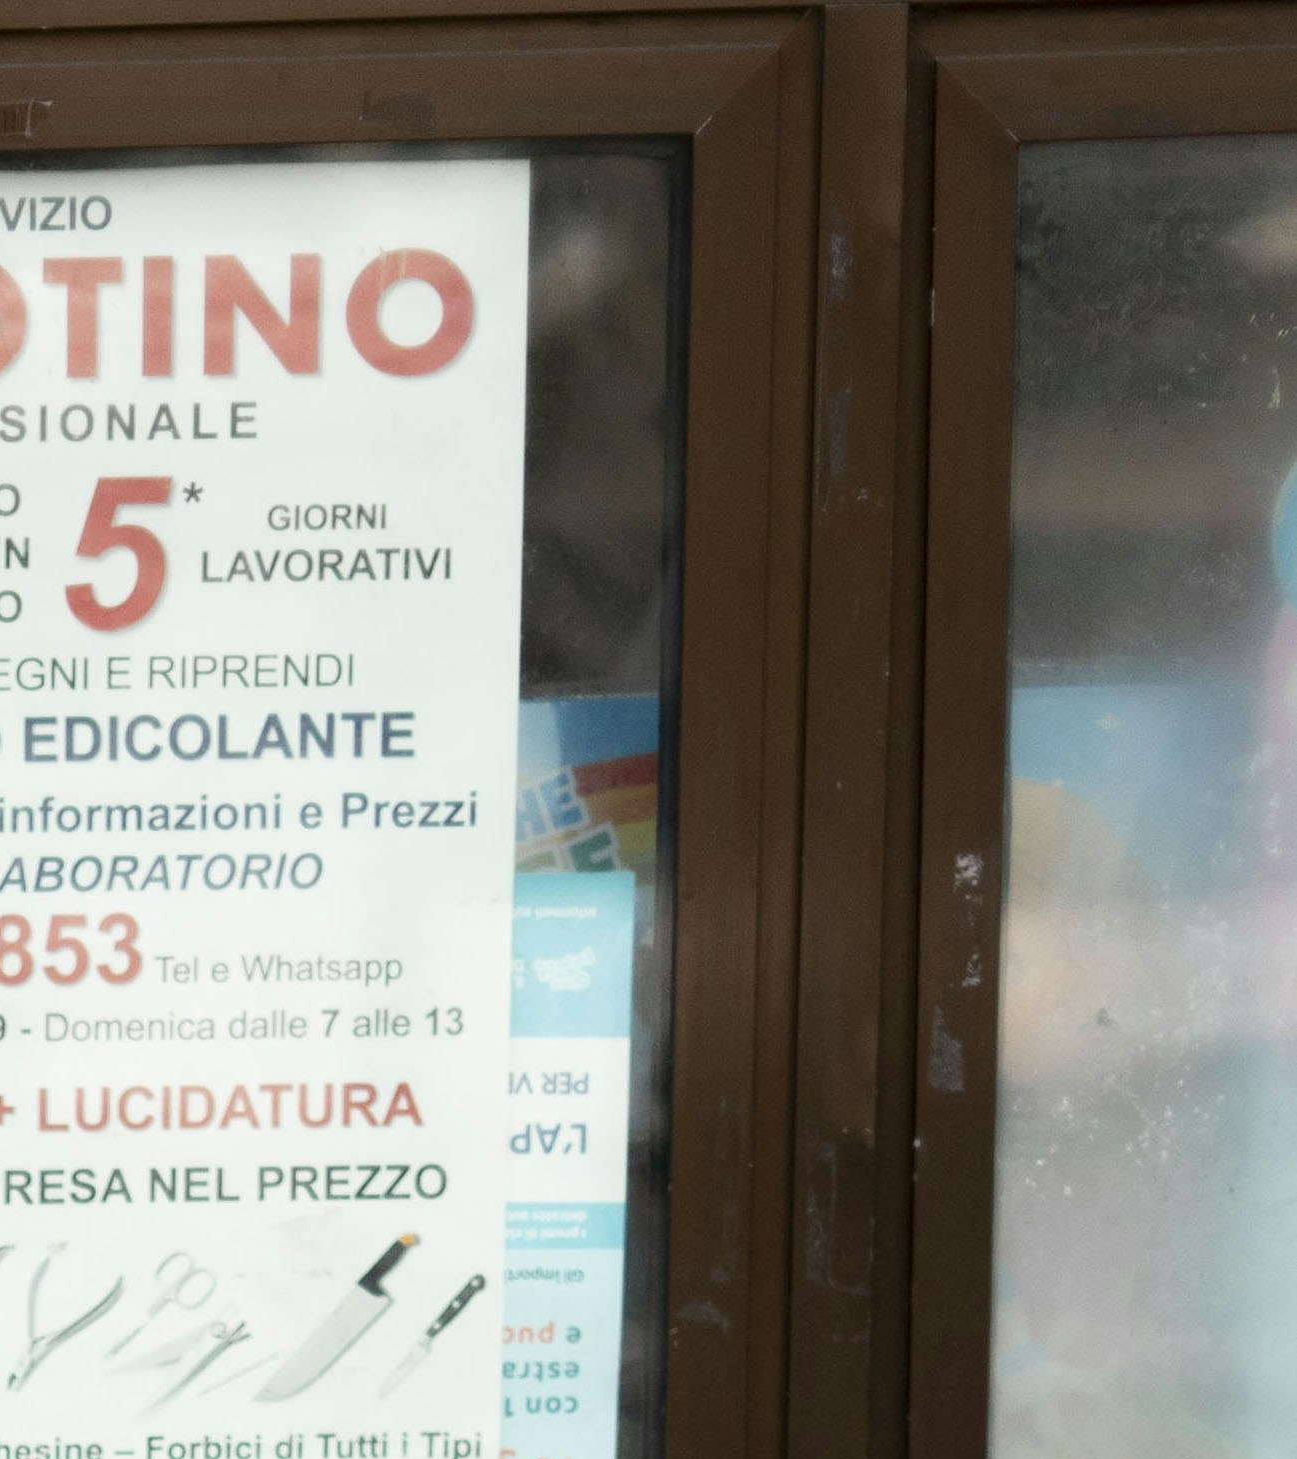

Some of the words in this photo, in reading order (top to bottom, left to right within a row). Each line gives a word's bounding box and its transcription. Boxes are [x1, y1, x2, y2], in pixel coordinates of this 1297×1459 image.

[267, 504, 387, 531] GIORNI
[201, 547, 452, 583] LAVORATIVI
[107, 656, 130, 689] E
[148, 654, 353, 689] RIPRENDI
[23, 712, 415, 762] EDICOLANTE
[341, 791, 477, 829] Prezzi
[241, 952, 402, 989] Whatsapp
[38, 1081, 423, 1134] LUCIDATURA
[150, 1167, 238, 1204] NEL
[258, 1163, 447, 1201] PREZZO
[526, 1396, 579, 1414] con
